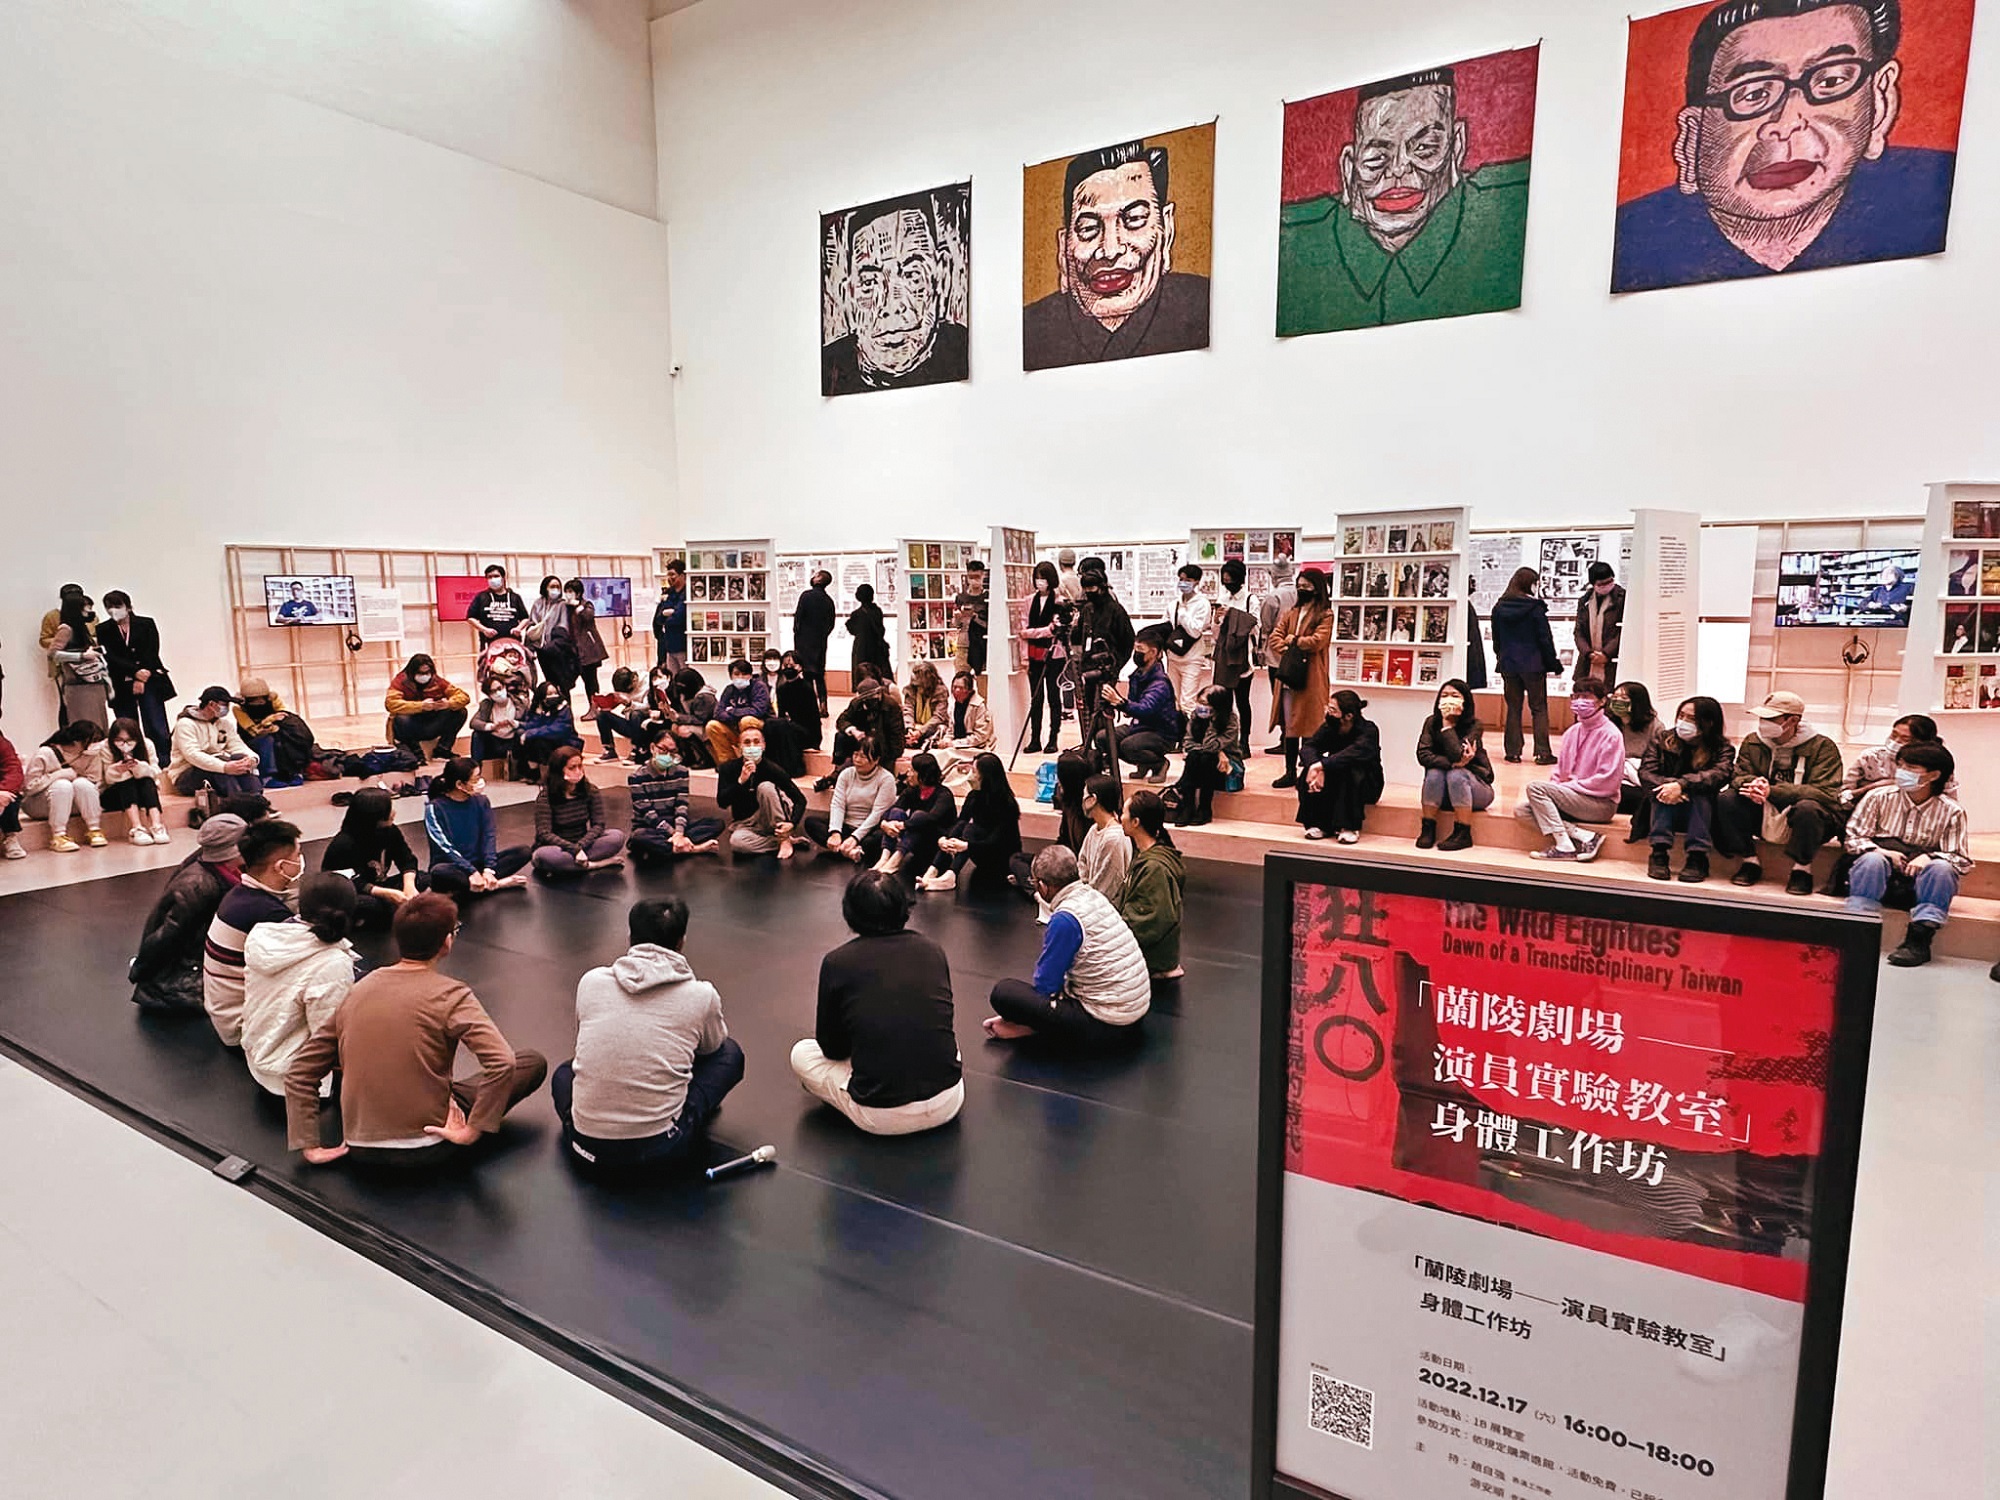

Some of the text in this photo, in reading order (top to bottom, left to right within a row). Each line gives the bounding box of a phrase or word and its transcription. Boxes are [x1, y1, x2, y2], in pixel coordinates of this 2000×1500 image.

[1443, 931, 1743, 996] Dawn of a Transdisciplinary Taiwan
[1430, 1102, 1668, 1187] 身體工作坊
[1420, 1293, 1532, 1340] 身體工作坊
[1419, 1368, 1528, 1414] 2022.12.17
